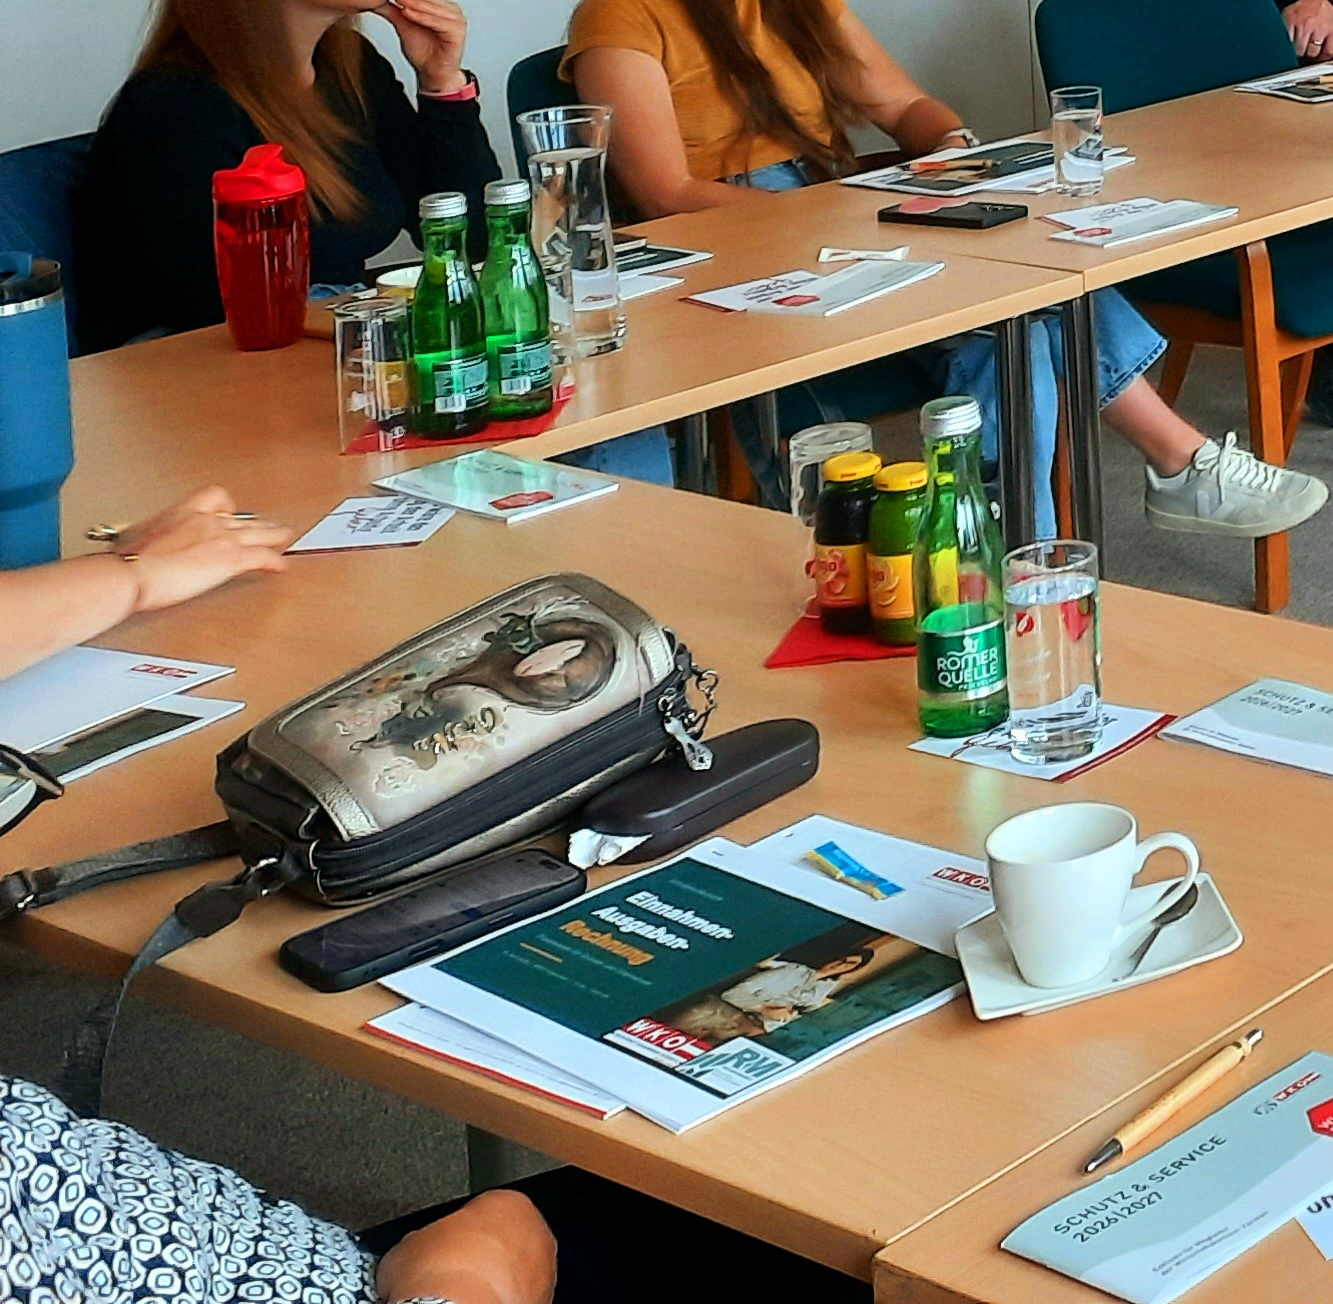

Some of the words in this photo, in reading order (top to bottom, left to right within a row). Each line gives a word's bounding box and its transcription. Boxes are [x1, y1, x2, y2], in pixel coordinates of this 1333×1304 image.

[937, 662, 998, 688] QUELLE
[936, 867, 986, 886] WKO
[590, 905, 690, 951] Ausgaben-
[625, 890, 735, 940] Einnahmen-
[626, 1017, 684, 1053] WKO
[1053, 1191, 1133, 1236] SCHUTZ
[1131, 1182, 1151, 1193] &
[1148, 1134, 1228, 1185] SERVICE
